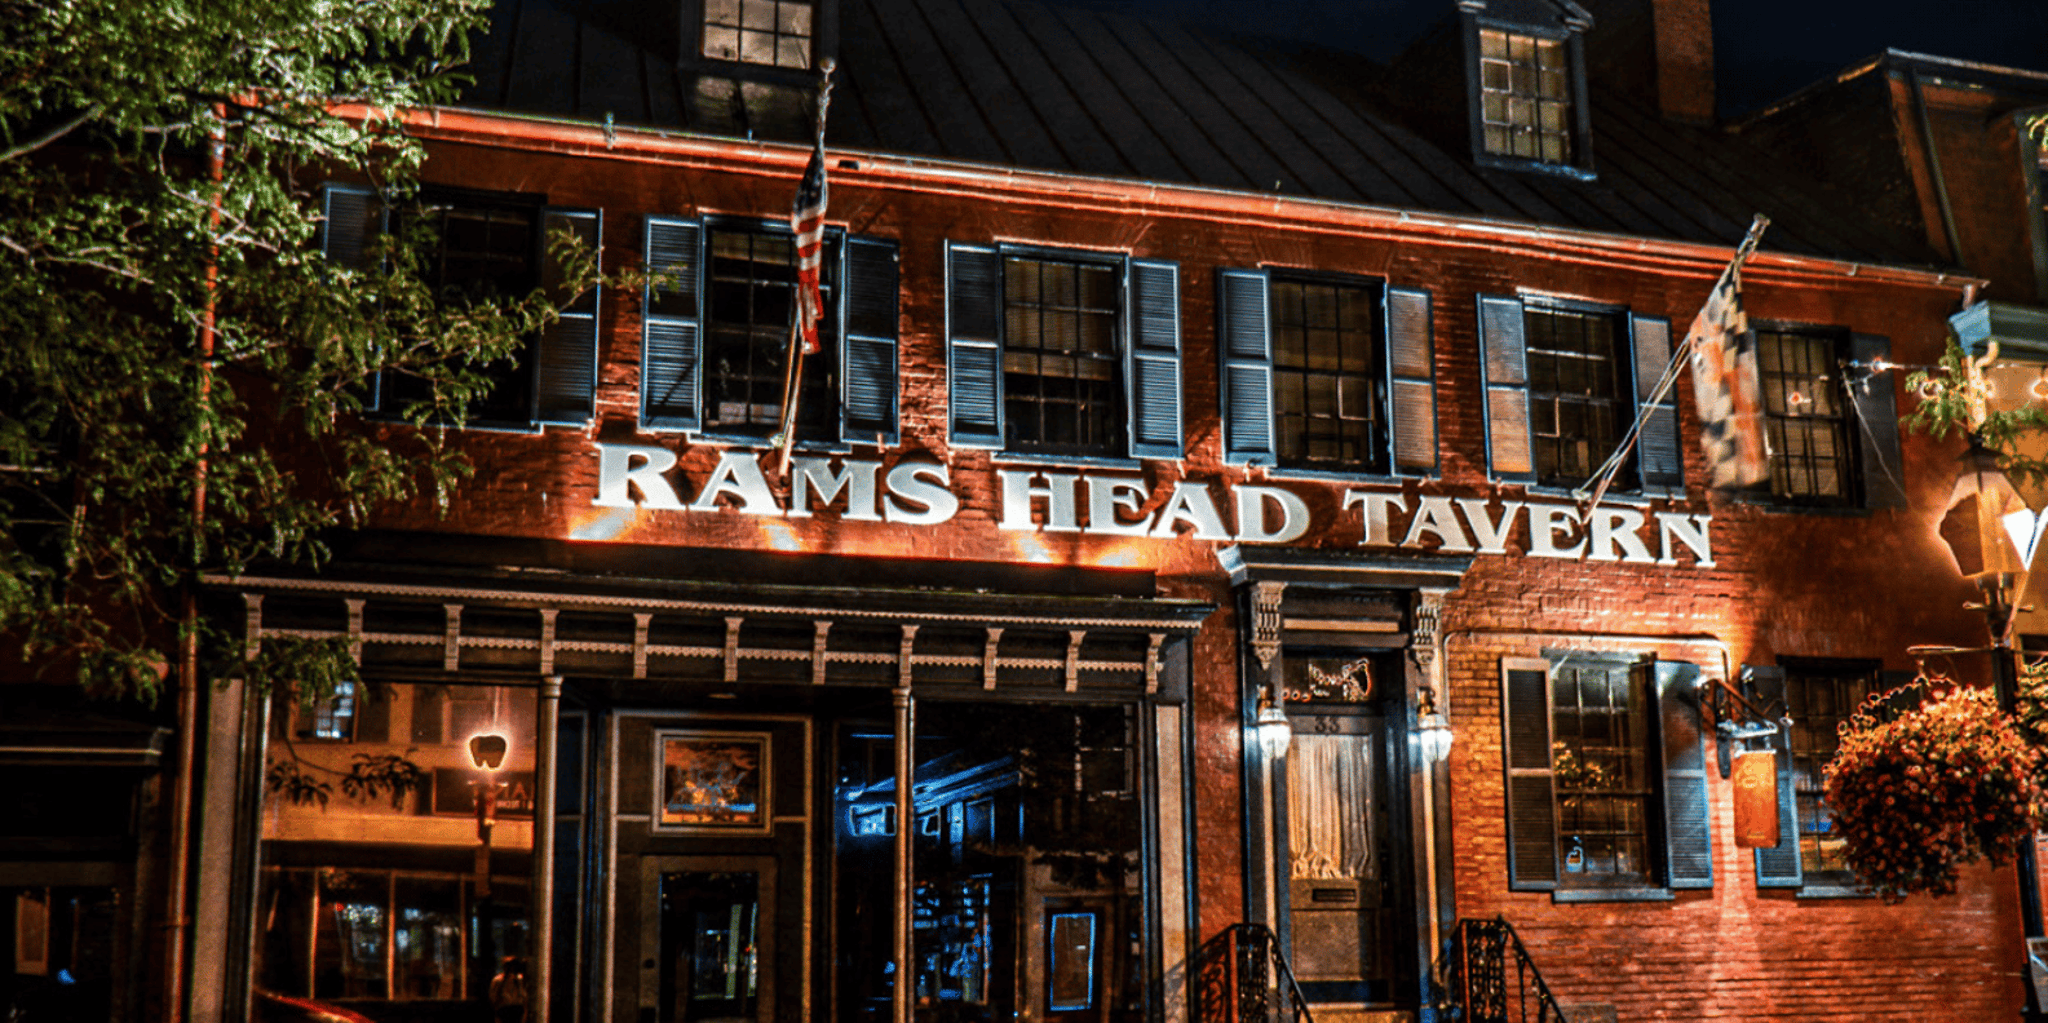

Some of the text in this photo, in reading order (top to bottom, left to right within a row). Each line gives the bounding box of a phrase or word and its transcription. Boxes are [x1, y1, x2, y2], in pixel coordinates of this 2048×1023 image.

[592, 443, 1716, 567] RAMS HEAD TAVERN
